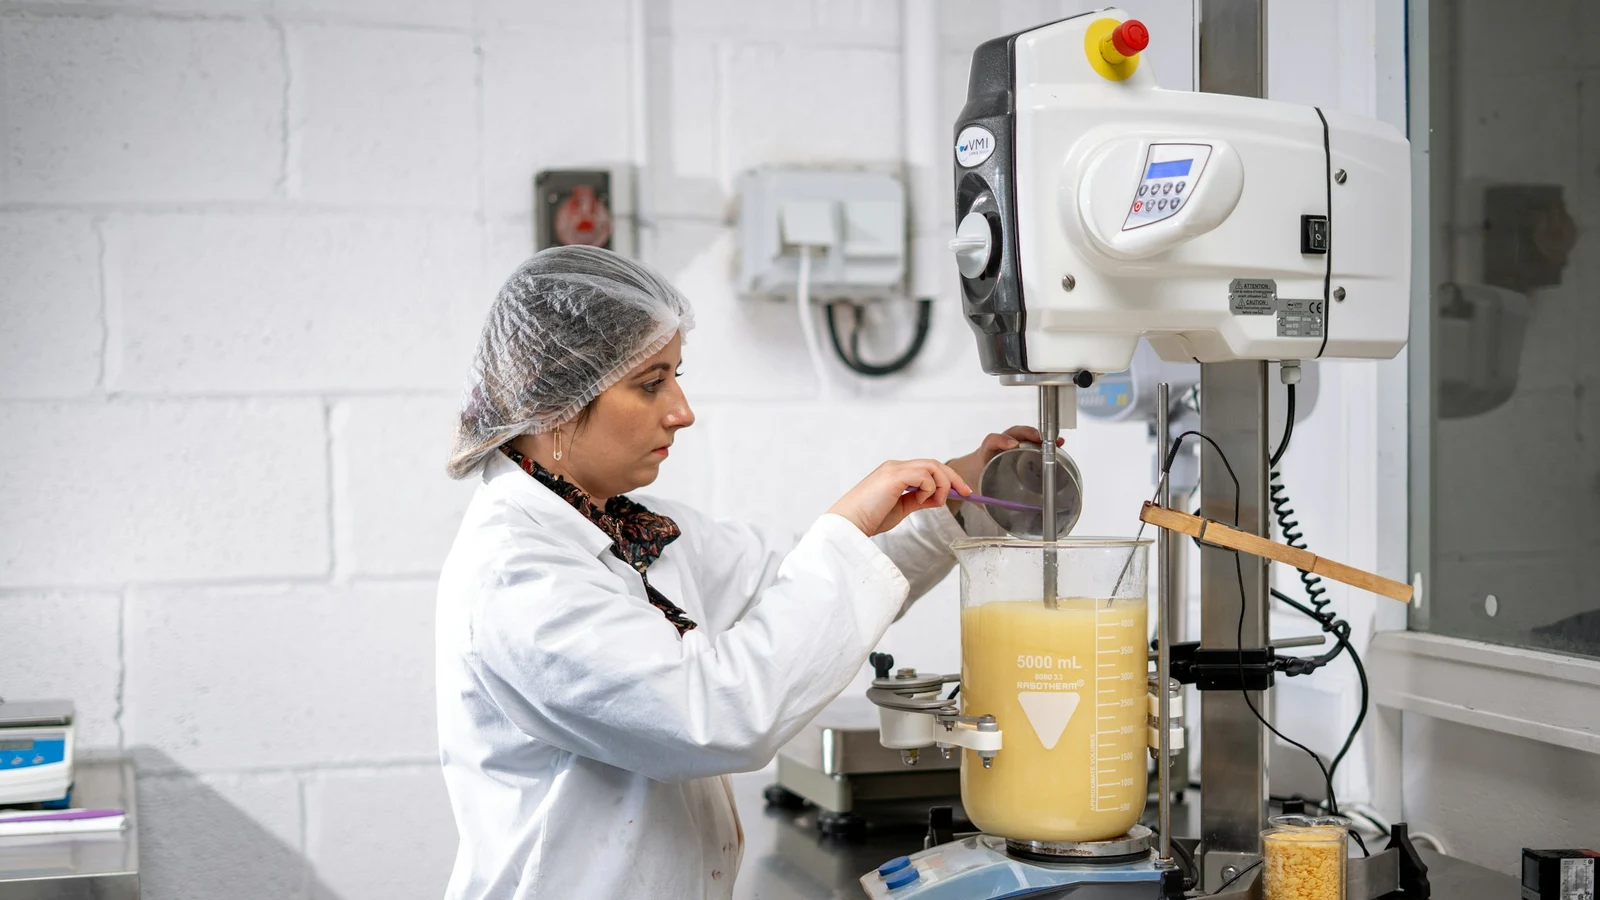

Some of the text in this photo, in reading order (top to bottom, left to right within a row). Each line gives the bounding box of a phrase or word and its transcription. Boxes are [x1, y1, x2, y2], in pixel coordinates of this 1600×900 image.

[968, 137, 989, 151] VMI
[1016, 655, 1082, 669] 5000 mL
[1120, 698, 1133, 707] 2500
[1121, 752, 1133, 761] 1500
[1121, 778, 1134, 787] 1000
